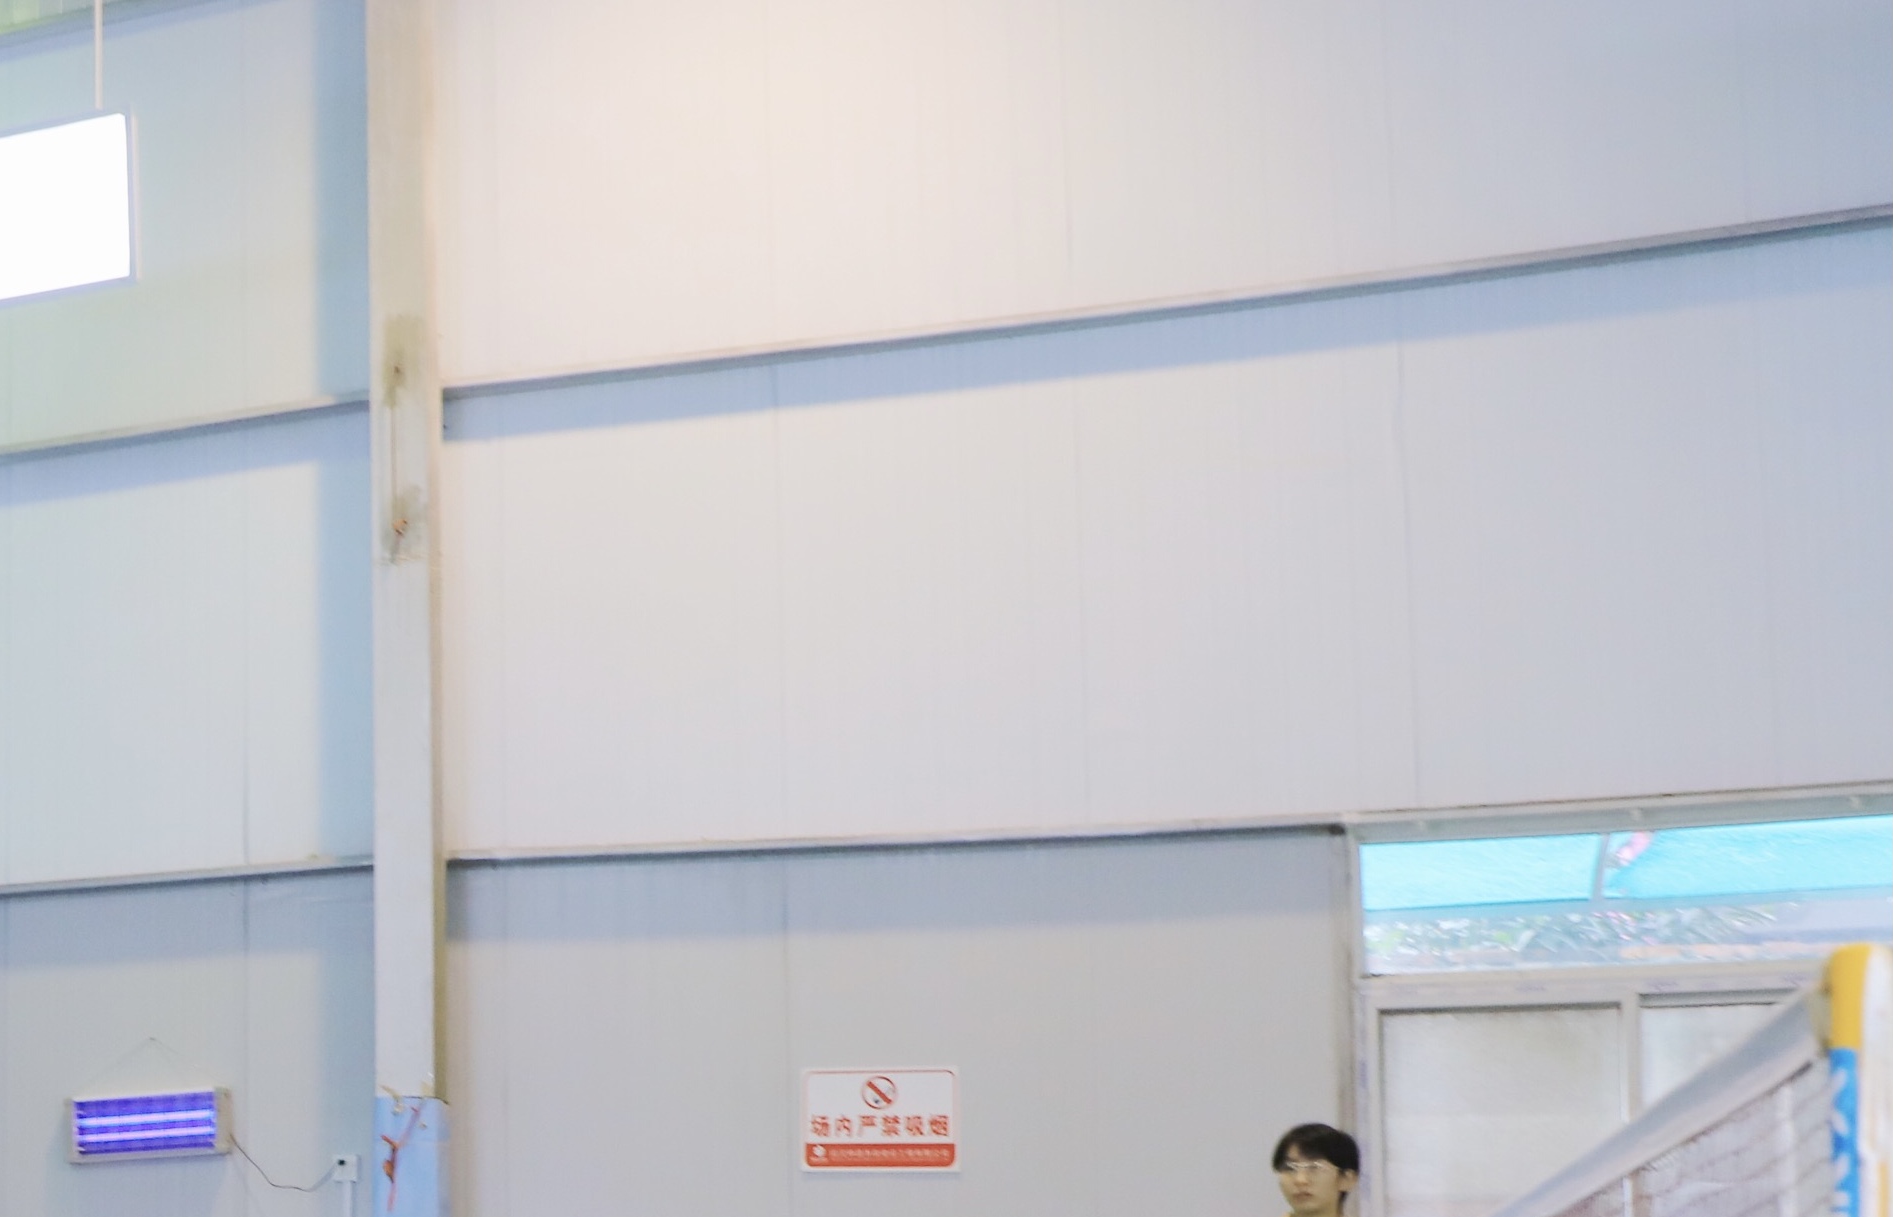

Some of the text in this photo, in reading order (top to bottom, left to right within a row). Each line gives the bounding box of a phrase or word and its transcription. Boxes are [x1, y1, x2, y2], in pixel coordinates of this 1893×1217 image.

[810, 1113, 950, 1137] 场内严禁吸烟
